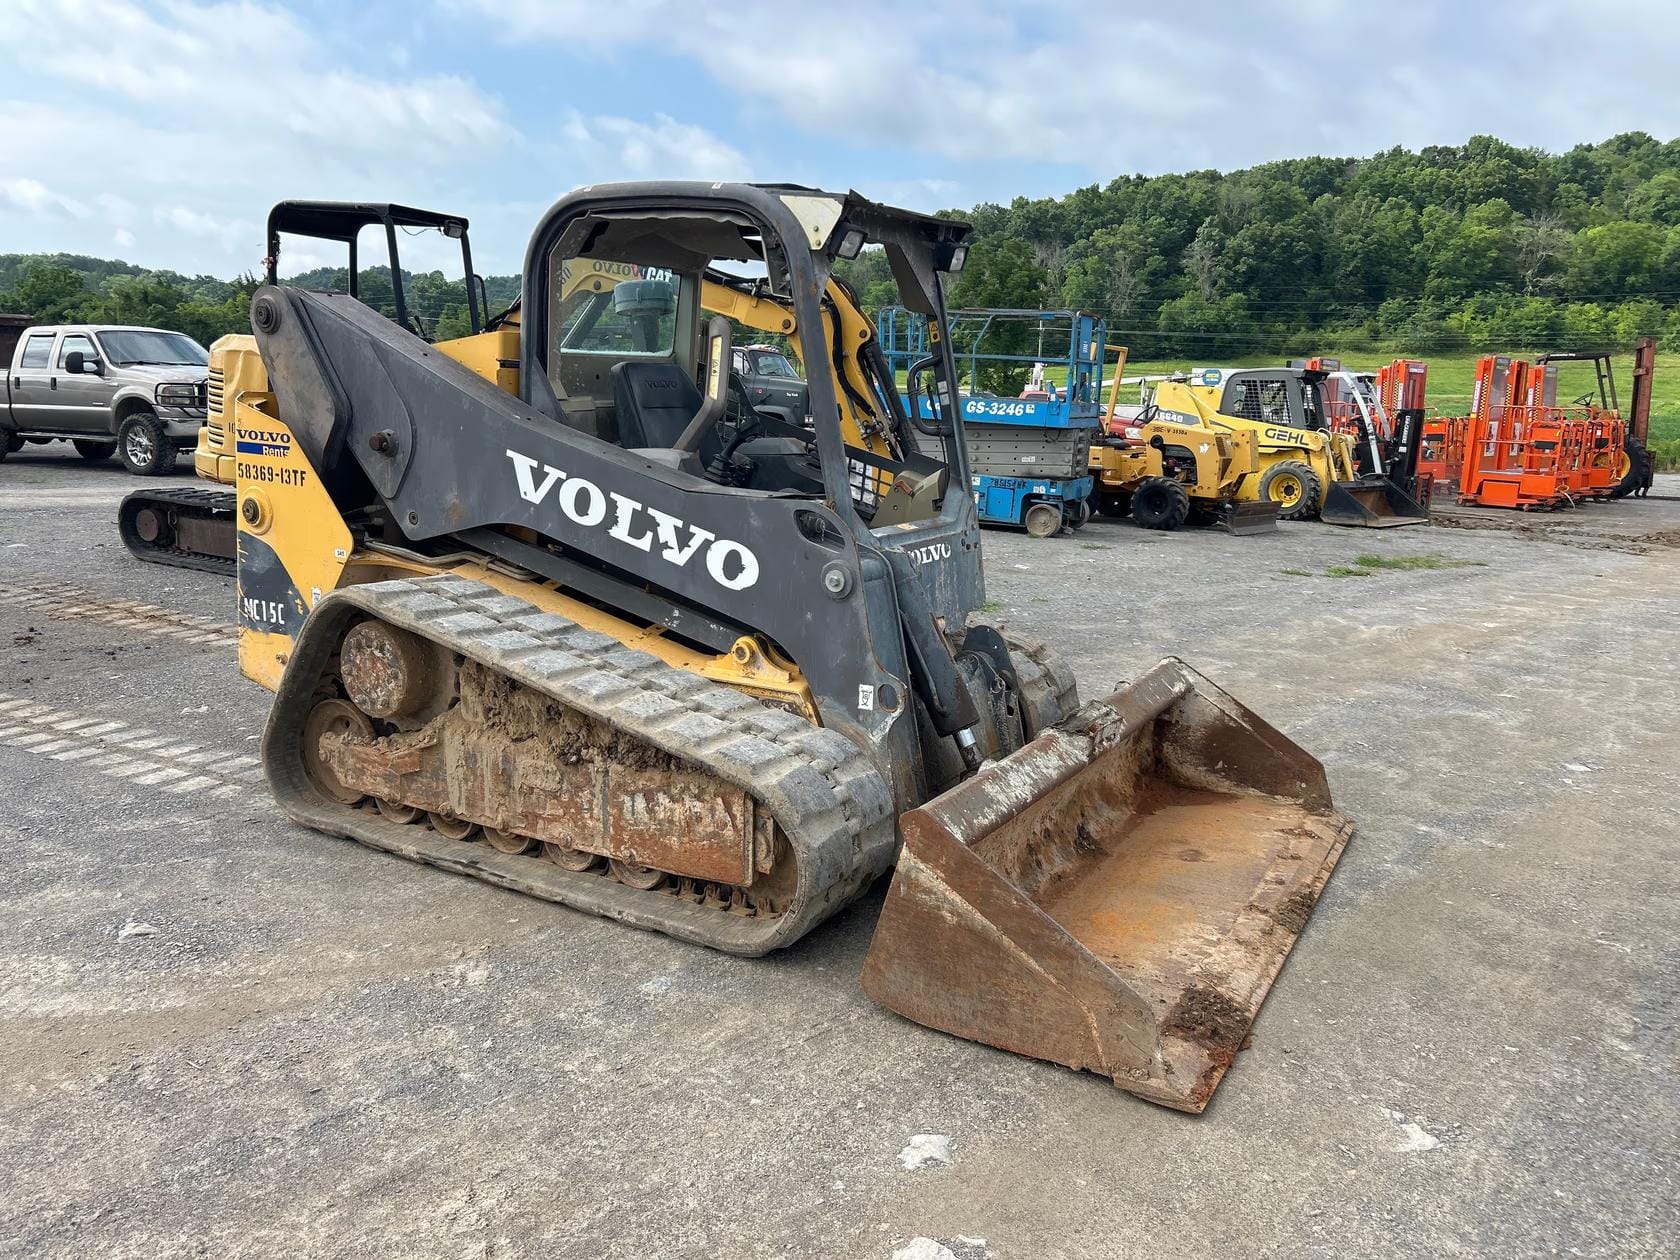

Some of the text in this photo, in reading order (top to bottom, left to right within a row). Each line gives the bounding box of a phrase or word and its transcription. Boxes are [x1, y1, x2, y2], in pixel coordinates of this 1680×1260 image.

[646, 267, 673, 282] CAT
[966, 401, 1025, 416] GS-3246
[236, 429, 290, 443] VOLVO
[1264, 428, 1309, 446] GEHL
[263, 446, 288, 458] Rents
[238, 463, 306, 486] 58369-13TF
[506, 449, 759, 591] VOLVO
